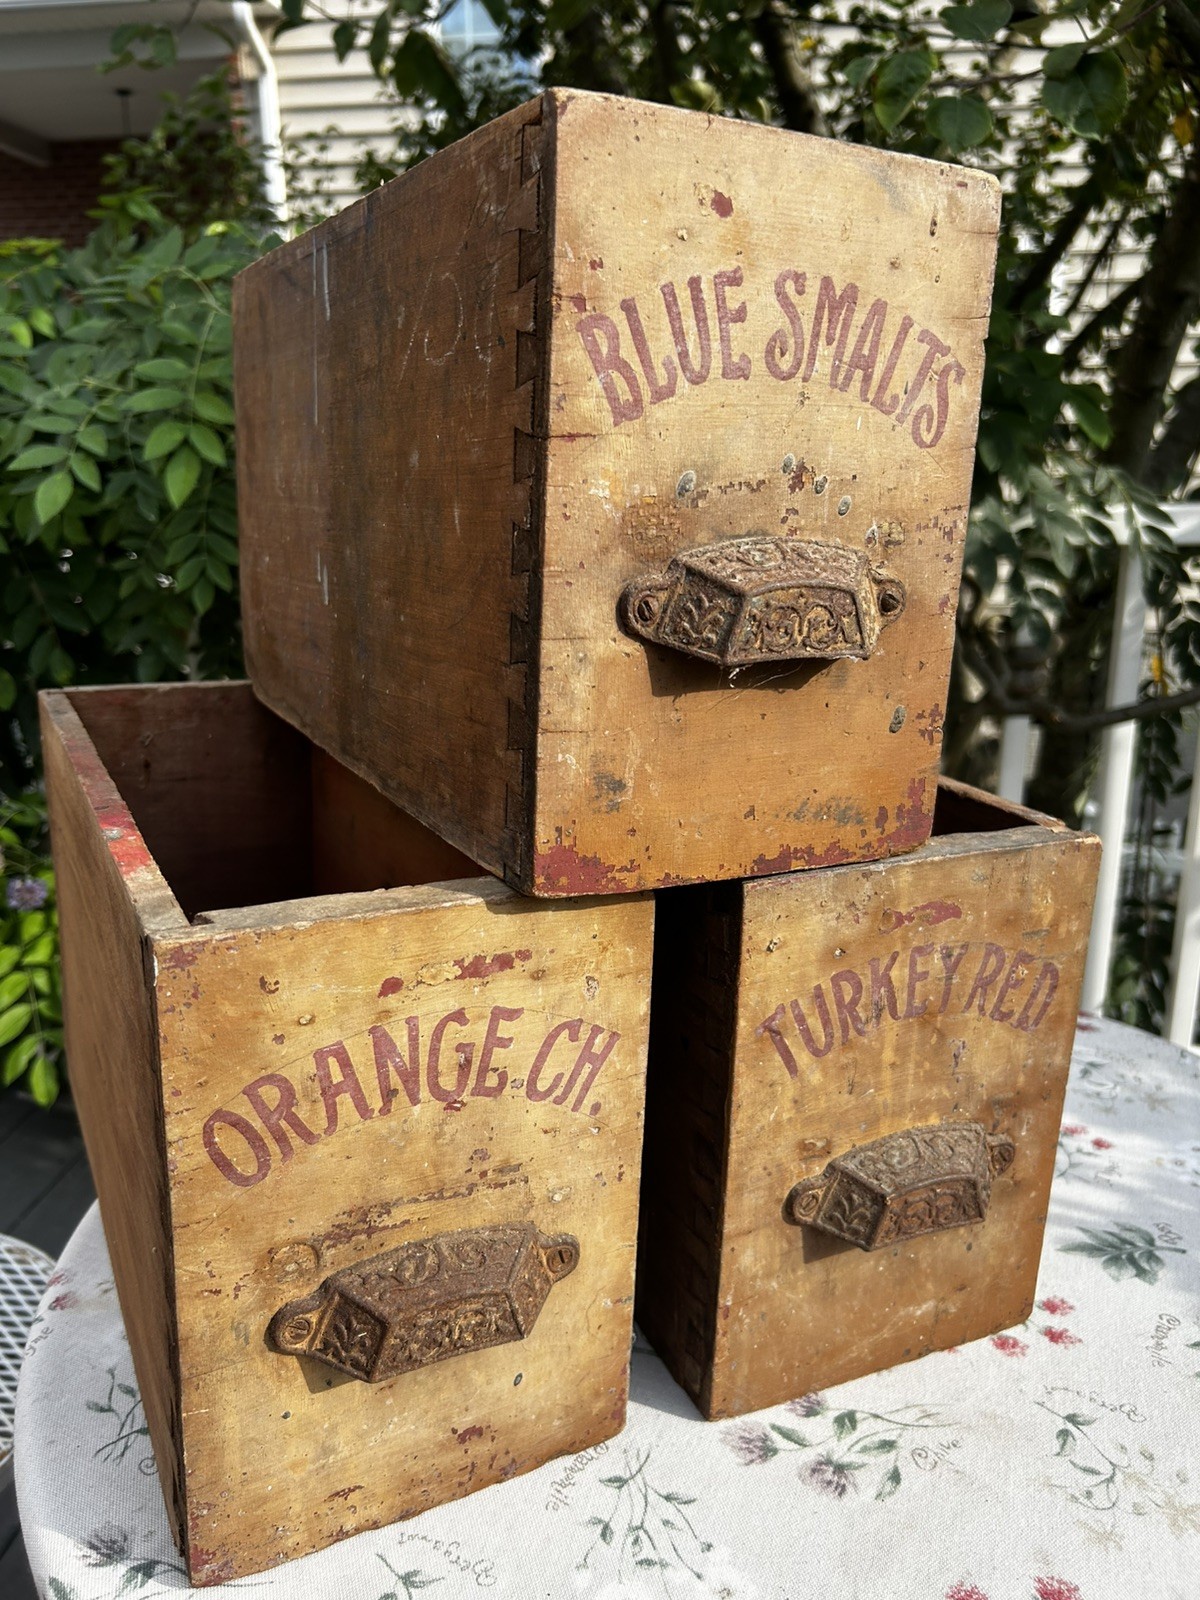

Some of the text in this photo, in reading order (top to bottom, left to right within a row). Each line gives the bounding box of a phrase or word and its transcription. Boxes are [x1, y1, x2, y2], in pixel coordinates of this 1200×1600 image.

[575, 265, 751, 428] BLUE
[764, 269, 966, 449] SMALTS
[202, 1005, 622, 1187] ORANGE CH.
[755, 942, 1060, 1079] TURKEY RED
